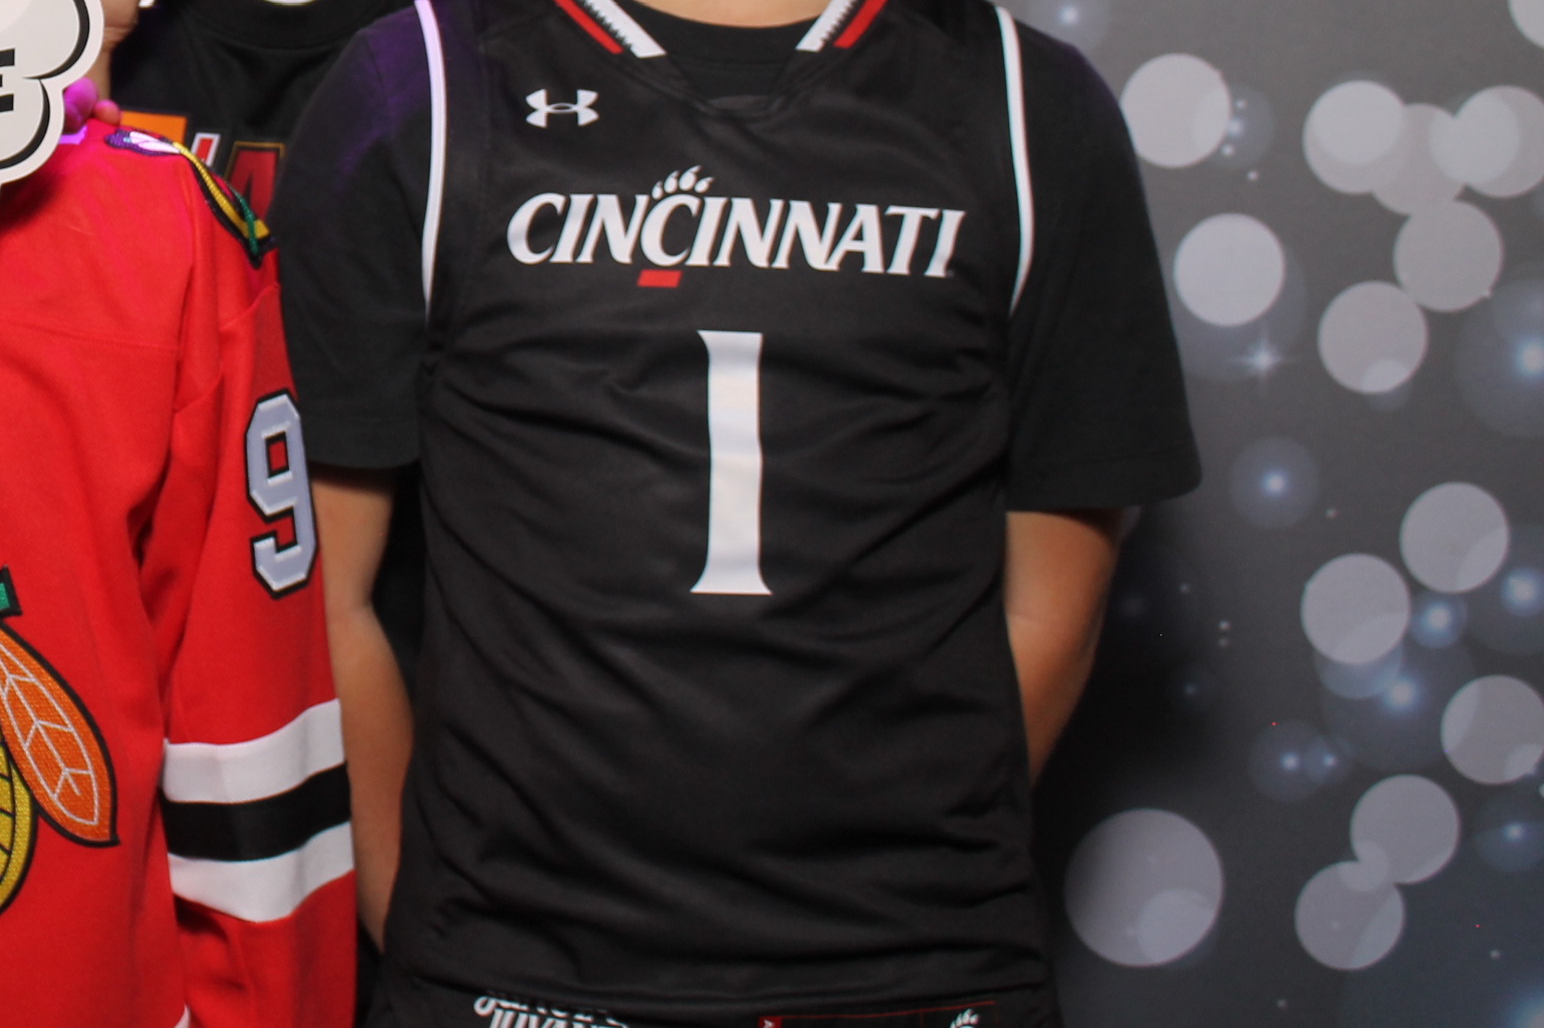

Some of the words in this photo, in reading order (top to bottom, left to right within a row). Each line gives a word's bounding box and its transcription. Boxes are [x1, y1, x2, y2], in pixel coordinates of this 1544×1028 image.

[506, 190, 966, 279] CINCINNATI
[246, 388, 318, 600] 9
[689, 328, 773, 596] 1
